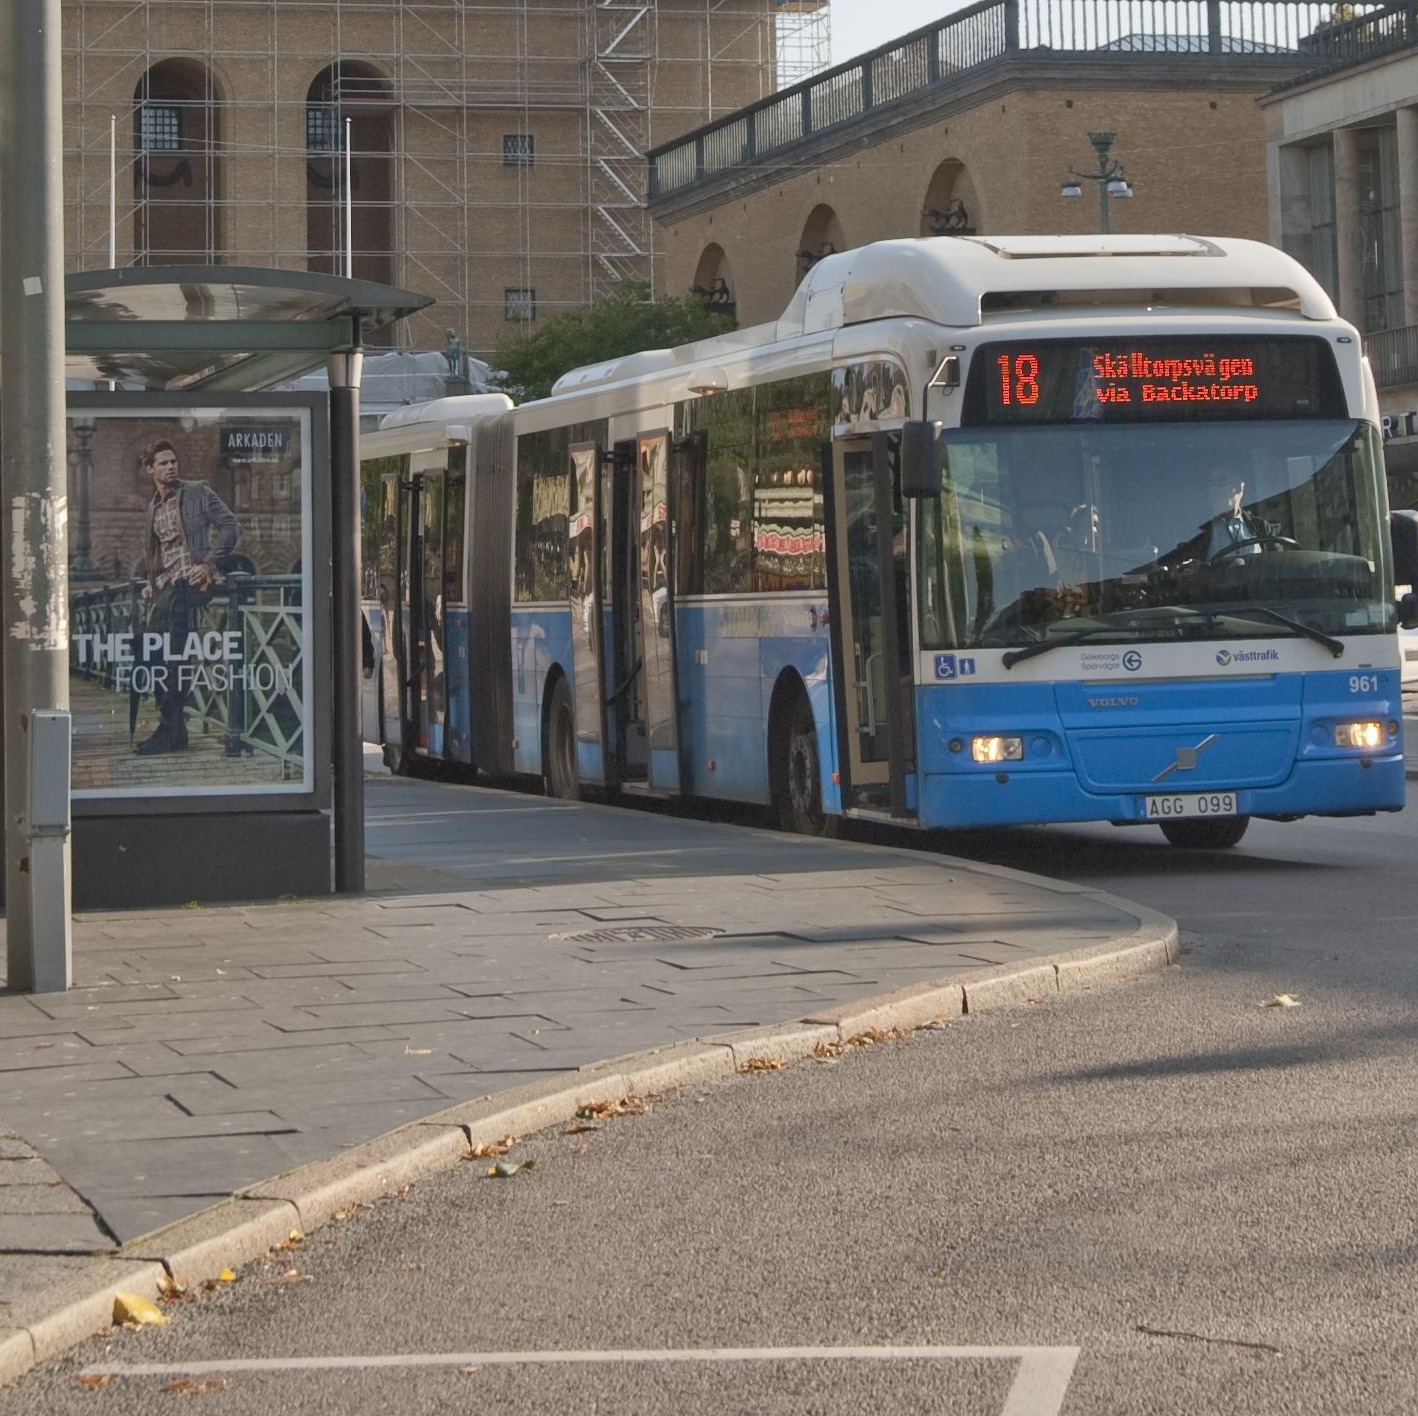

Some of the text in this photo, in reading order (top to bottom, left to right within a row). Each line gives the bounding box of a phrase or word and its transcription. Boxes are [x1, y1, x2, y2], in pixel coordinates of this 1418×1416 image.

[997, 353, 1039, 406] 18
[1096, 380, 1258, 403] via Backatorp
[227, 433, 283, 449] ARKADEN
[71, 630, 244, 664] THE PLACE
[1233, 649, 1279, 663] västtrafik
[115, 663, 294, 694] FOR FASHION
[1349, 675, 1379, 693] 961
[1087, 696, 1139, 708] VOLVO
[1150, 794, 1233, 815] AGG 099
